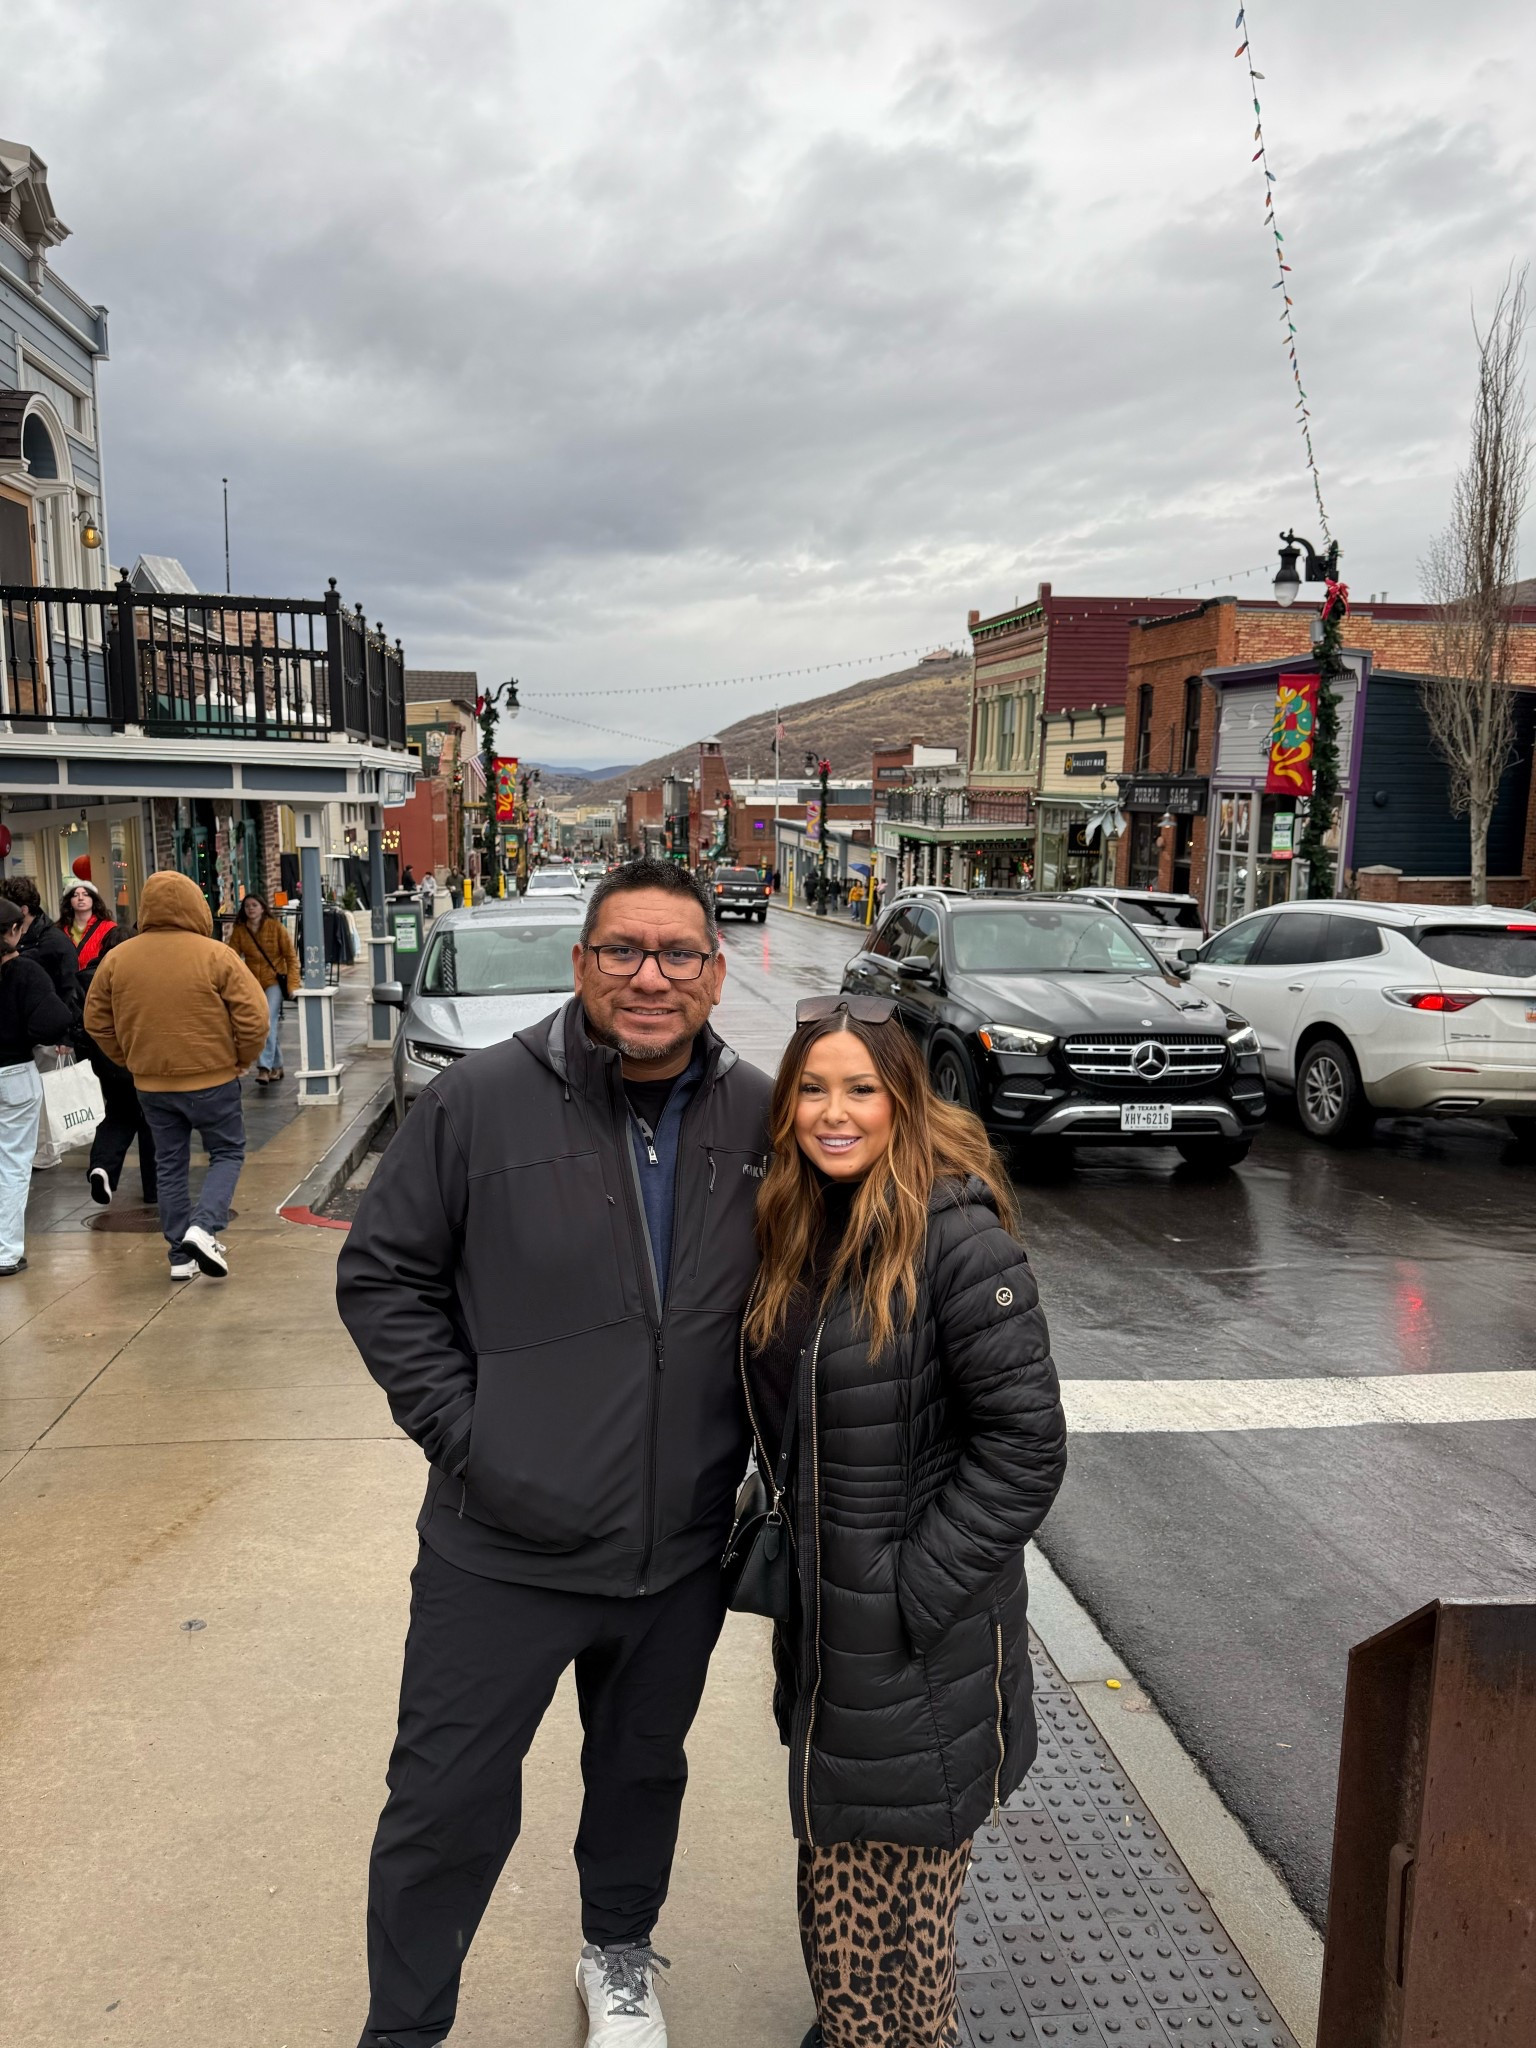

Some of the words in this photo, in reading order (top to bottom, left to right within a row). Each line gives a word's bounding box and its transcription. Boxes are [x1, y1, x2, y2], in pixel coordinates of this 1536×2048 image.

[1134, 787, 1160, 804] PURPLE
[1169, 787, 1189, 804] SAGE
[63, 1106, 95, 1130] HILDA
